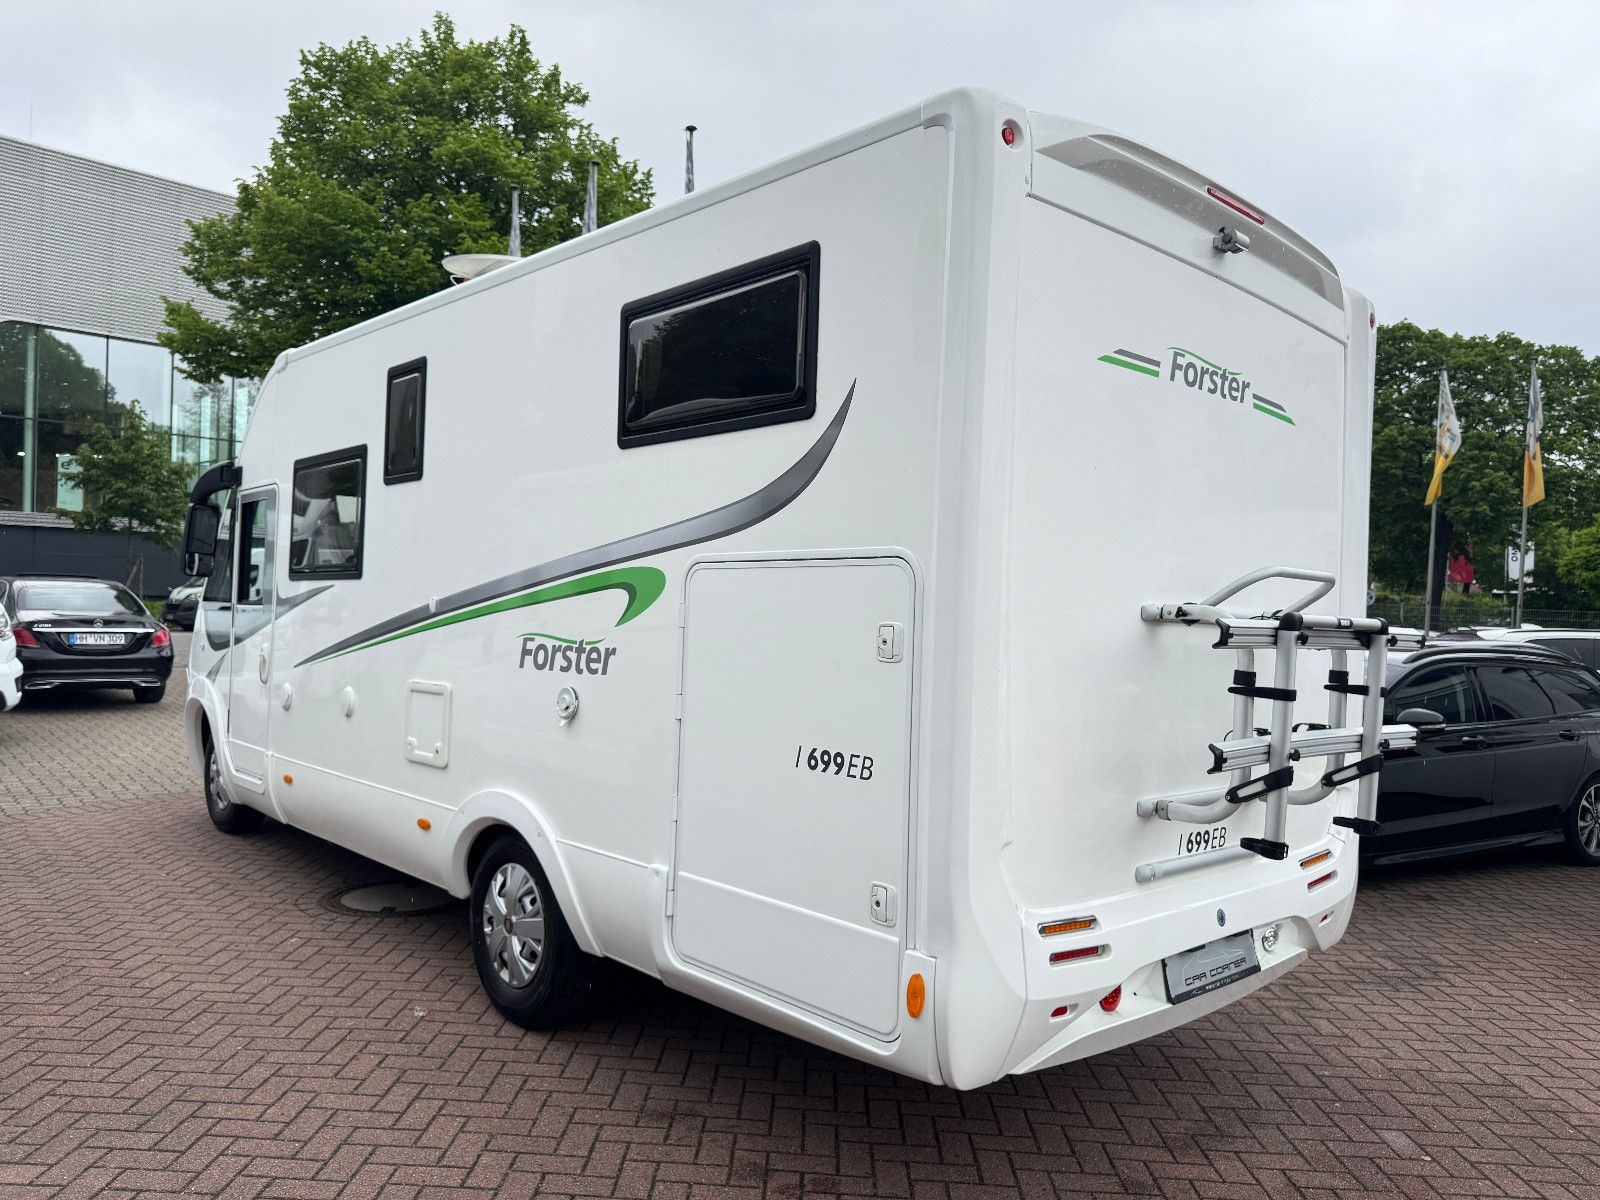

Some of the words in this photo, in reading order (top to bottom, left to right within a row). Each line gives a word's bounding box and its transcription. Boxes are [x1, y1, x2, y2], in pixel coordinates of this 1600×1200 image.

[1169, 350, 1251, 404] Forster
[93, 634, 106, 643] VN
[519, 637, 617, 676] Forster
[807, 747, 874, 781] 699EB
[1186, 826, 1227, 854] 699EB
[1184, 971, 1208, 986] CAR
[1209, 957, 1248, 977] CORNER
